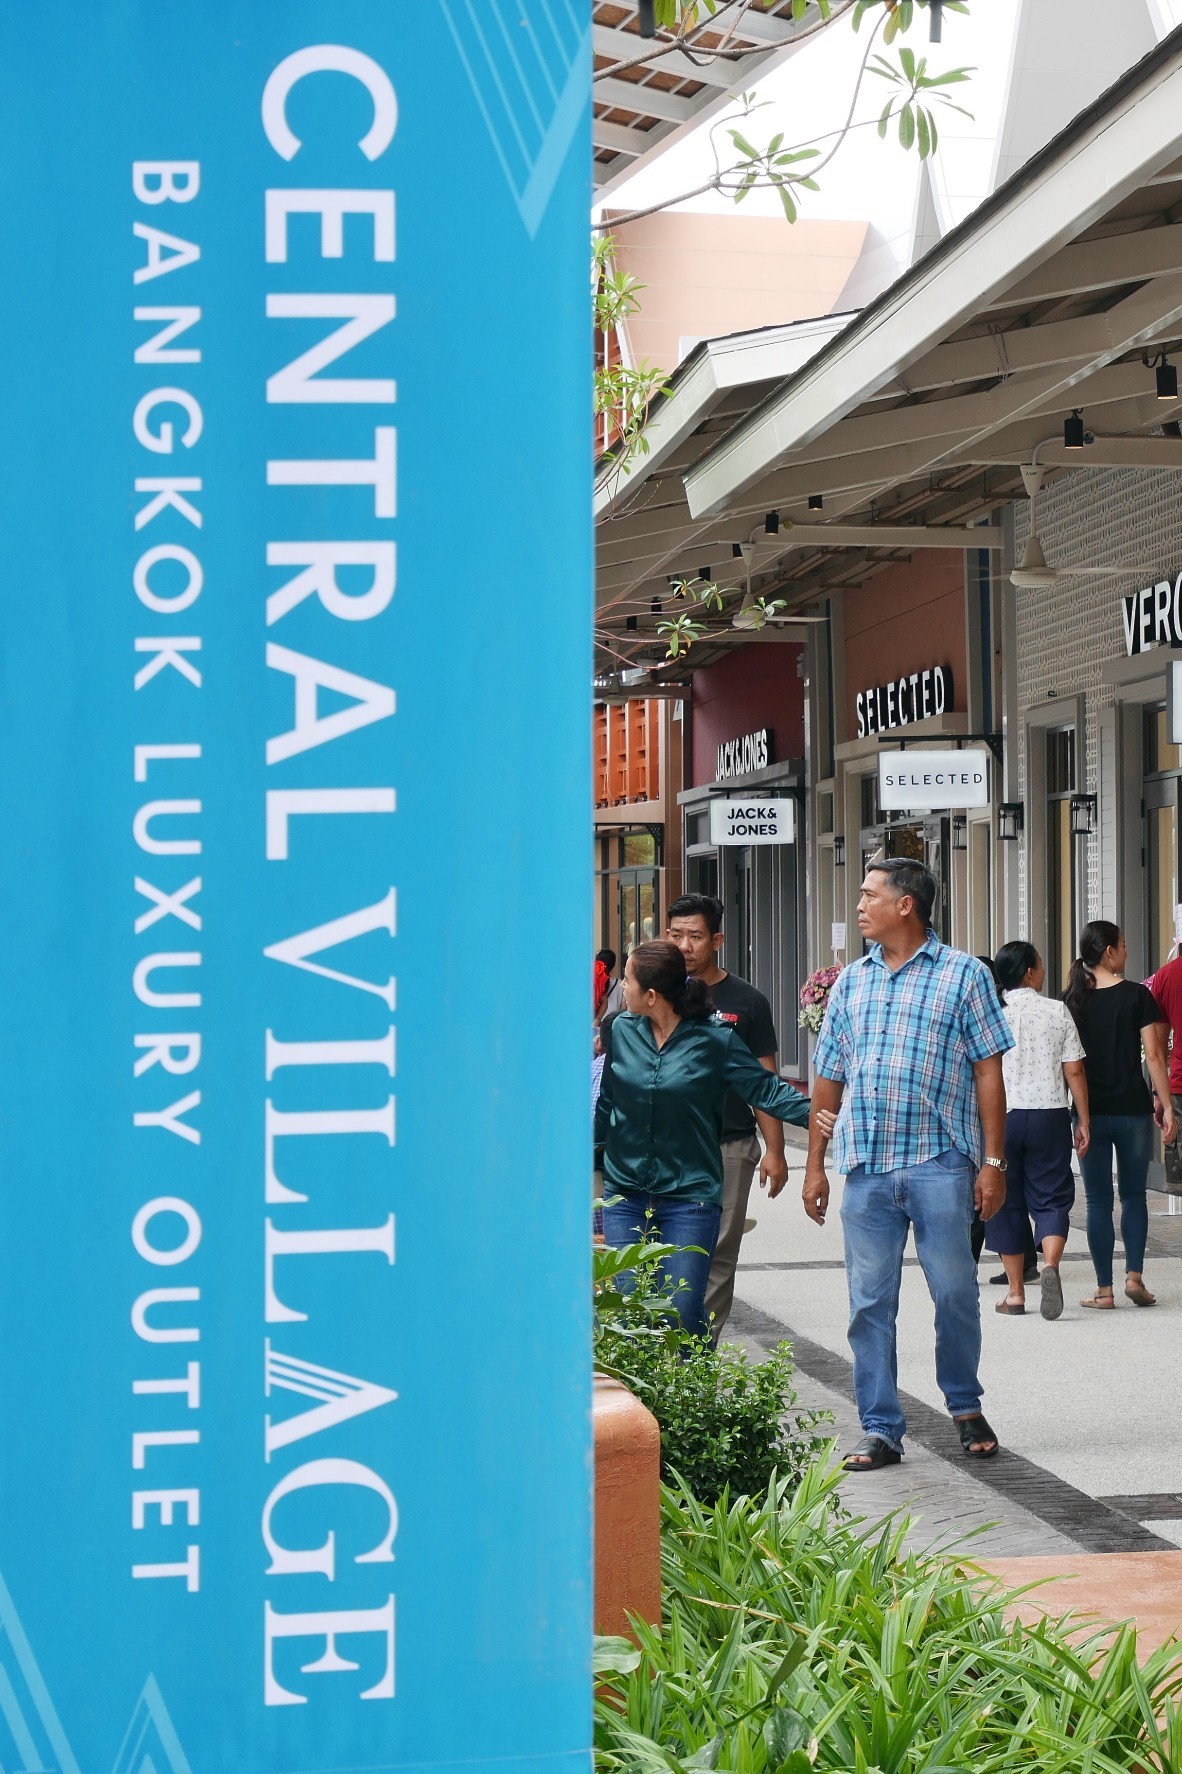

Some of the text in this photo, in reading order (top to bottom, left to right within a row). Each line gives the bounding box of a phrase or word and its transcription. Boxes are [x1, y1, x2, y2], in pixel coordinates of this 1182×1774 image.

[856, 666, 945, 739] SELECTED
[885, 773, 983, 786] SELECTED
[727, 807, 777, 820] JACK&
[727, 823, 778, 836] JONES
[131, 161, 203, 1592] BANGKOK LUXURY OUTLET
[261, 44, 398, 1706] CENTRAL VILLAGE
